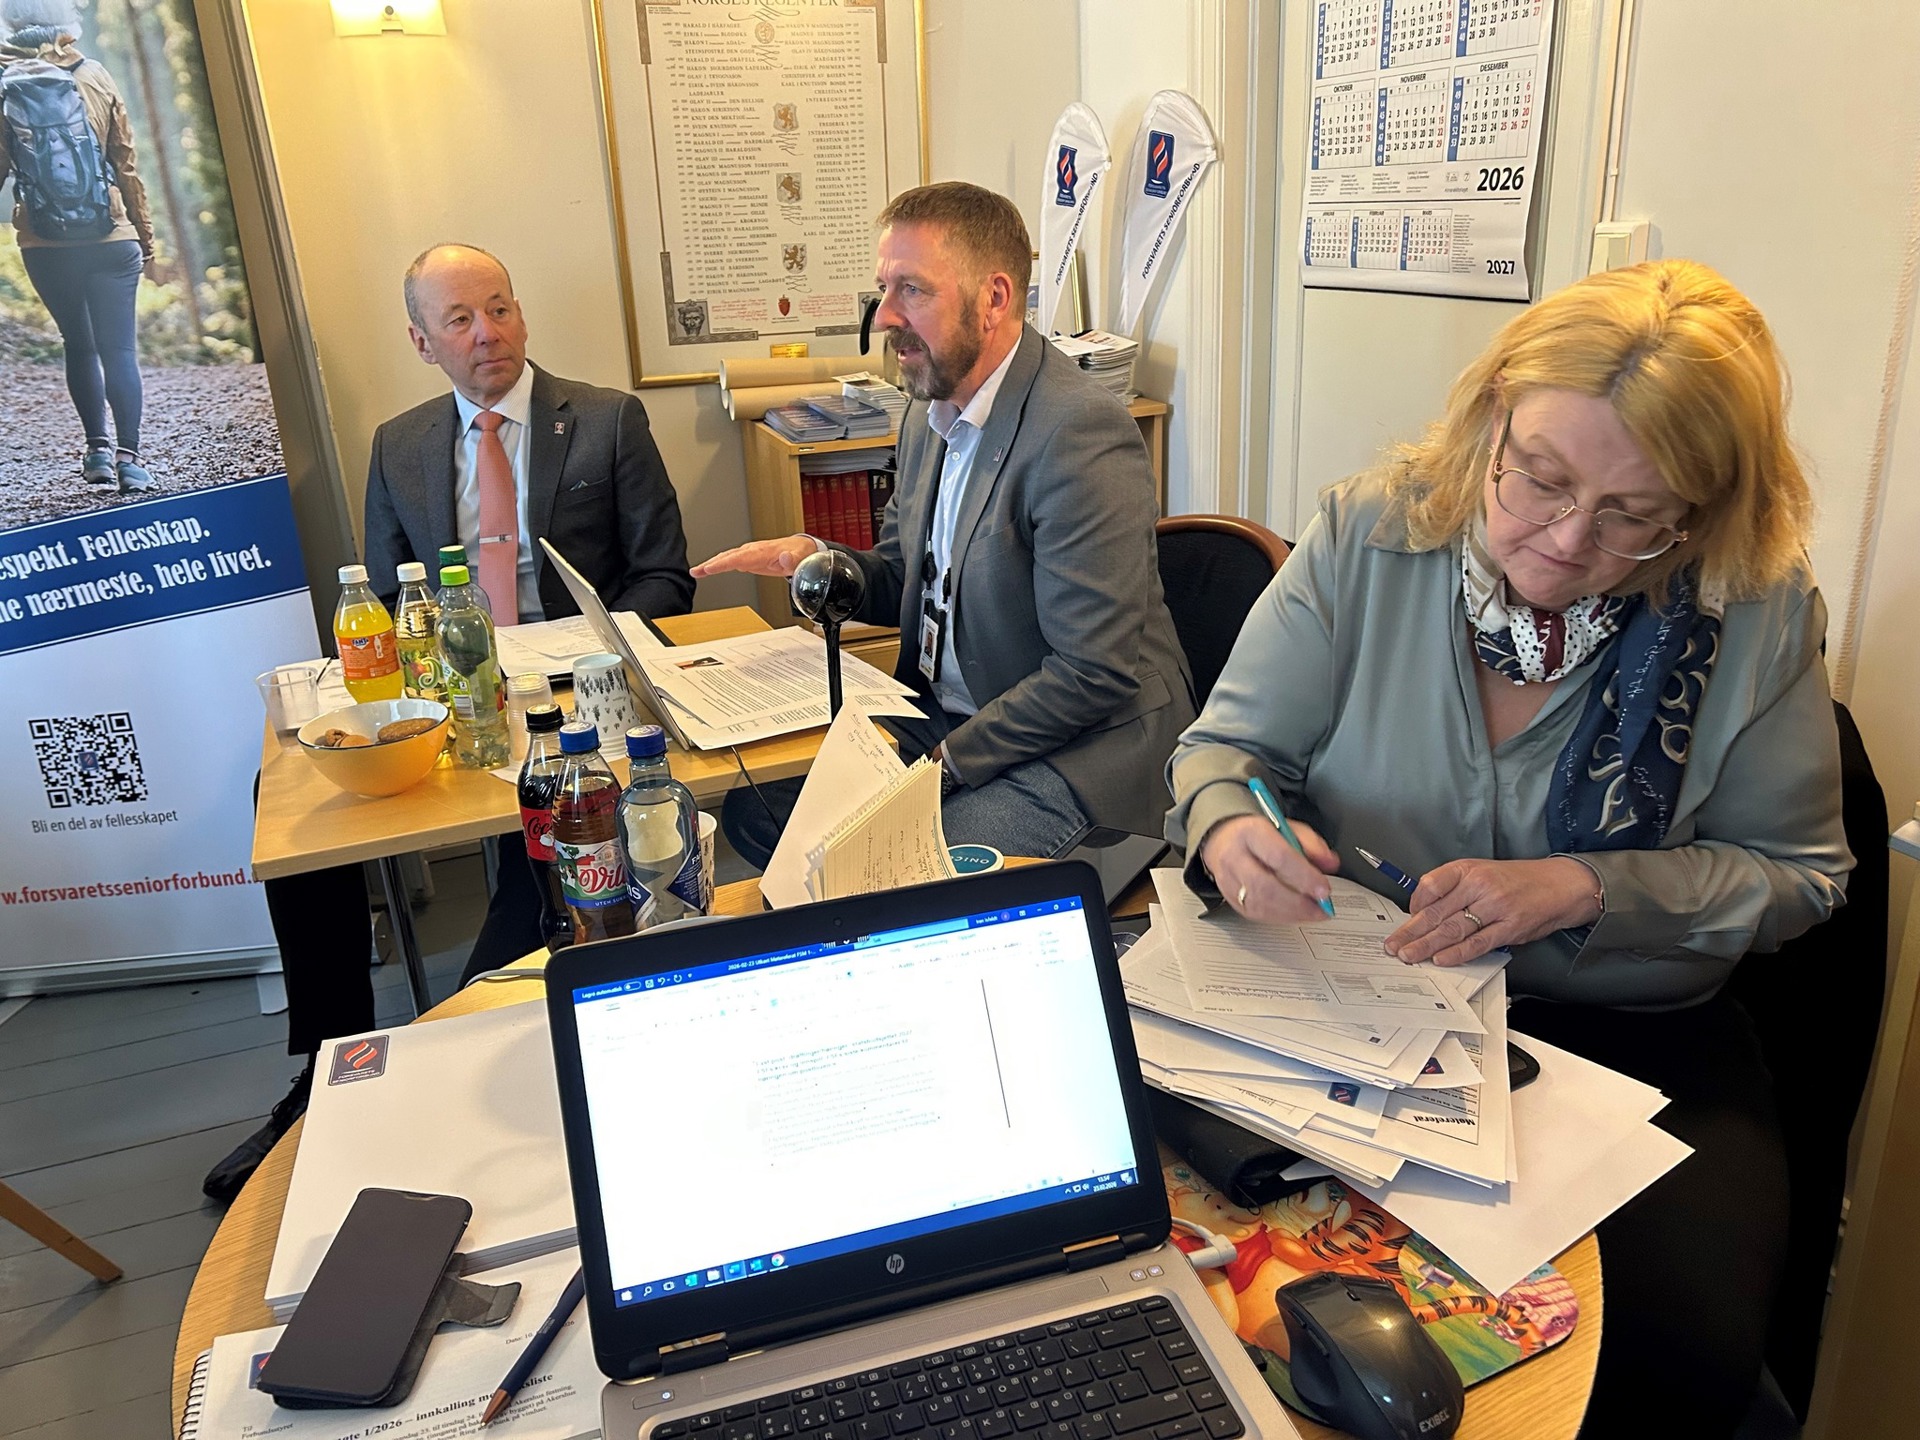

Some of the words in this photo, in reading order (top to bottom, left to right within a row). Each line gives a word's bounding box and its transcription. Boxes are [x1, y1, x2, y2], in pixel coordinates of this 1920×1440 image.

[1400, 73, 1426, 83] NOVEMBER
[1480, 61, 1508, 72] DESEMBER
[1334, 84, 1353, 92] OKTOBER
[1477, 167, 1525, 191] 2026
[1142, 225, 1167, 280] FORSVARETS
[1487, 260, 1515, 275] 2027
[77, 517, 210, 561] Fellesskap.
[24, 571, 153, 616] nærmeste,
[153, 558, 207, 589] hele
[207, 543, 272, 578] livet.
[32, 820, 48, 833] Bli
[51, 821, 66, 832] en
[68, 817, 86, 830] del
[90, 818, 101, 829] av
[106, 810, 178, 827] fellesskapet
[0, 868, 263, 905] w.forsvaretsseniorforbund.
[579, 864, 627, 895] Vill
[887, 1255, 903, 1272] hp
[364, 1419, 403, 1437] 1/2026
[416, 1398, 476, 1421] innkalling
[1419, 1408, 1450, 1433] EXIBEL
